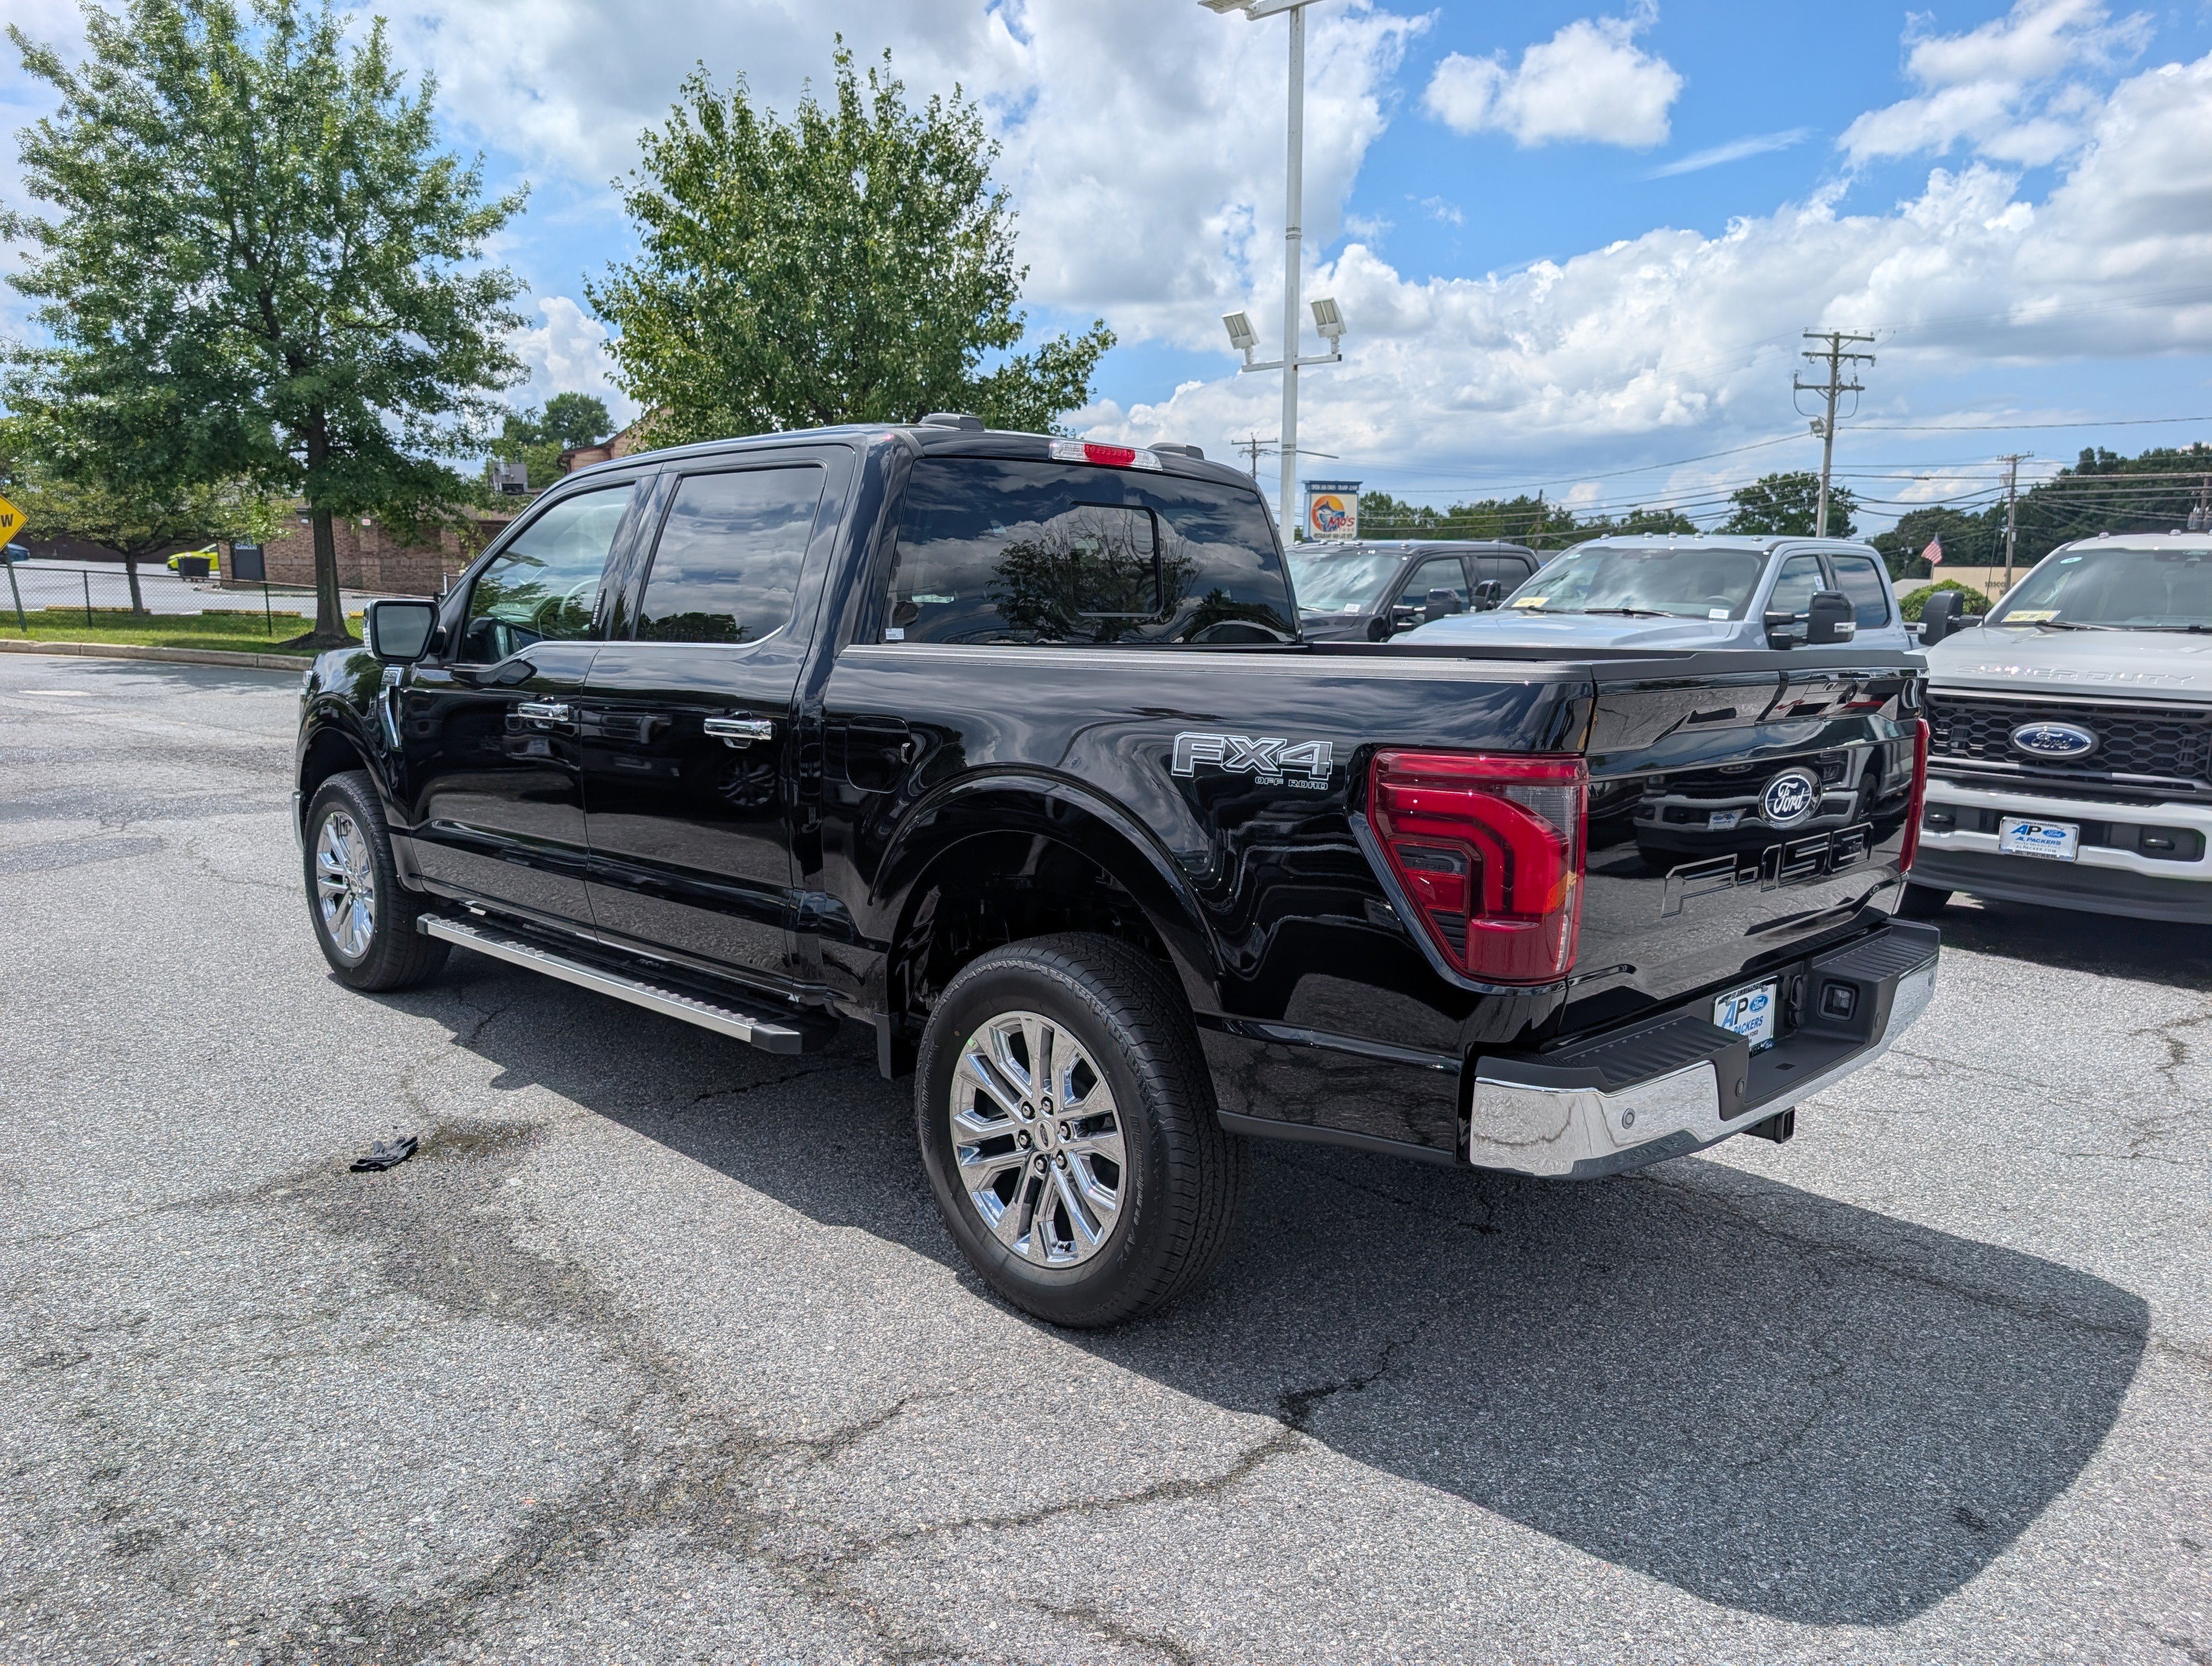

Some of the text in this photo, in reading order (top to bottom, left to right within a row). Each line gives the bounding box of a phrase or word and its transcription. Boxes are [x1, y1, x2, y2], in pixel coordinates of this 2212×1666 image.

[2086, 671, 2195, 685] DUTY
[2031, 732, 2073, 749] Ford
[1172, 731, 1333, 780] FX4
[1255, 776, 1328, 790] OFF ROAD
[1773, 781, 1805, 813] Ford
[2010, 824, 2042, 836] AP
[1661, 821, 1874, 919] F-150
[1721, 997, 1748, 1028] AP
